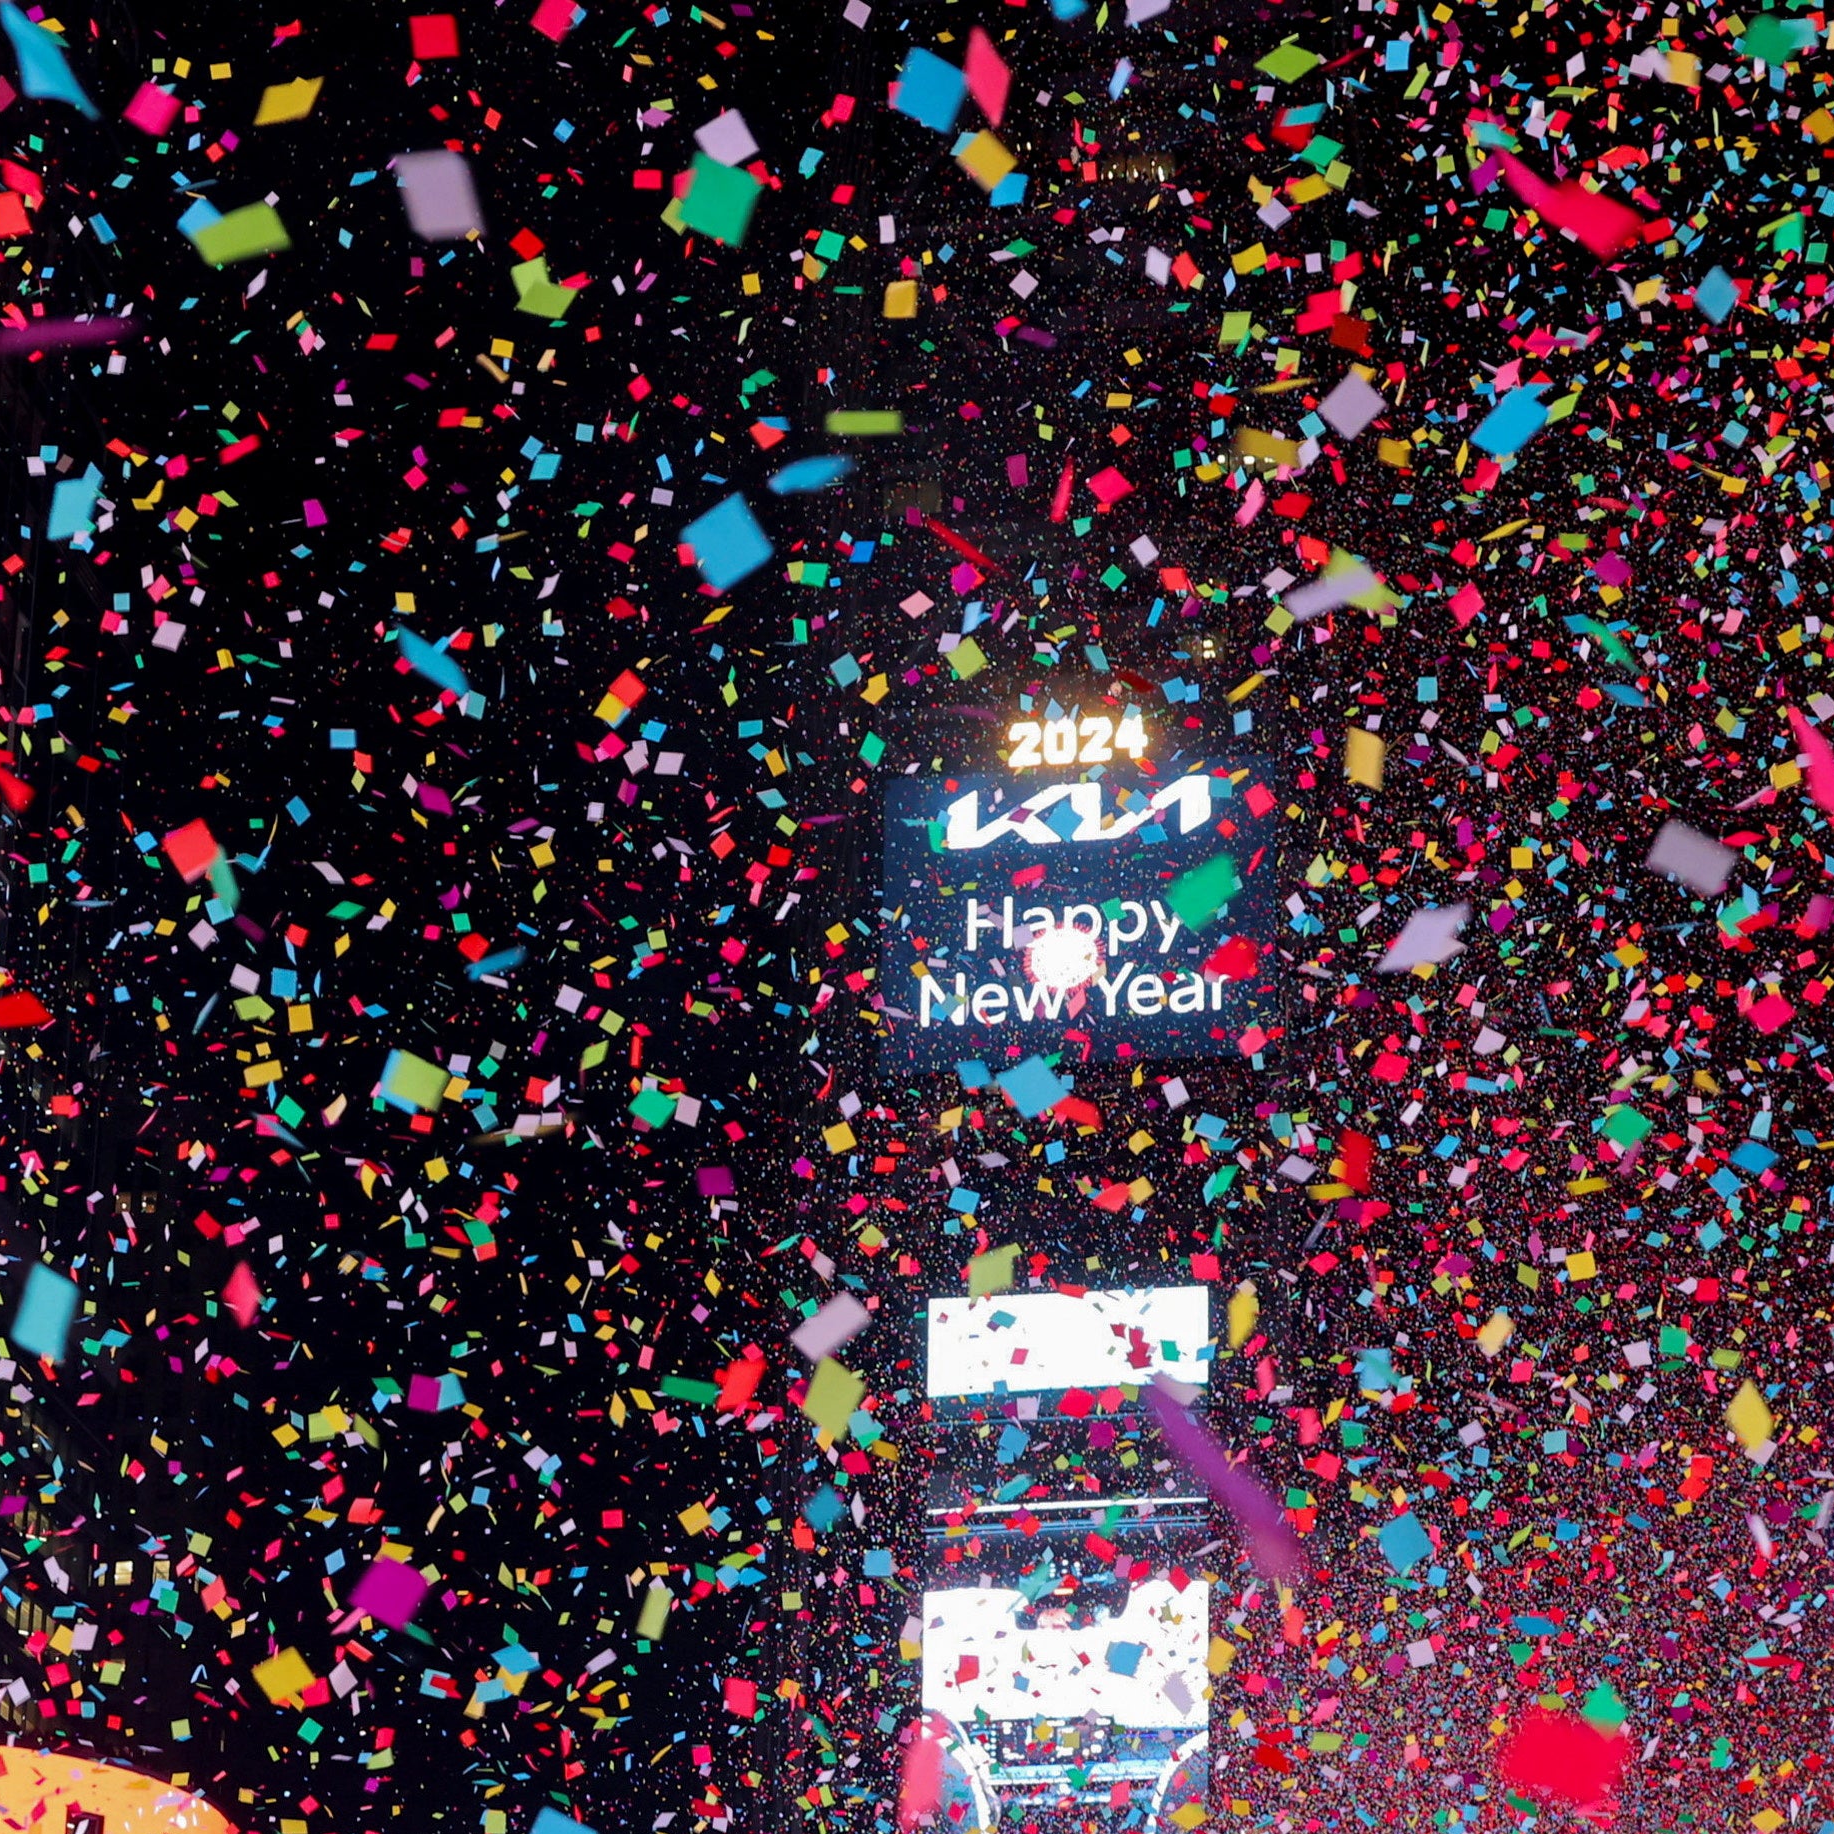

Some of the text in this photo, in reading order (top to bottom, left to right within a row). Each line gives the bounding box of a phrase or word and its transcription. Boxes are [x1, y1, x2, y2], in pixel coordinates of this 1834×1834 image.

[1009, 716, 1148, 767] 2024
[967, 896, 1181, 956] Happy
[920, 962, 1229, 1028] New Year
